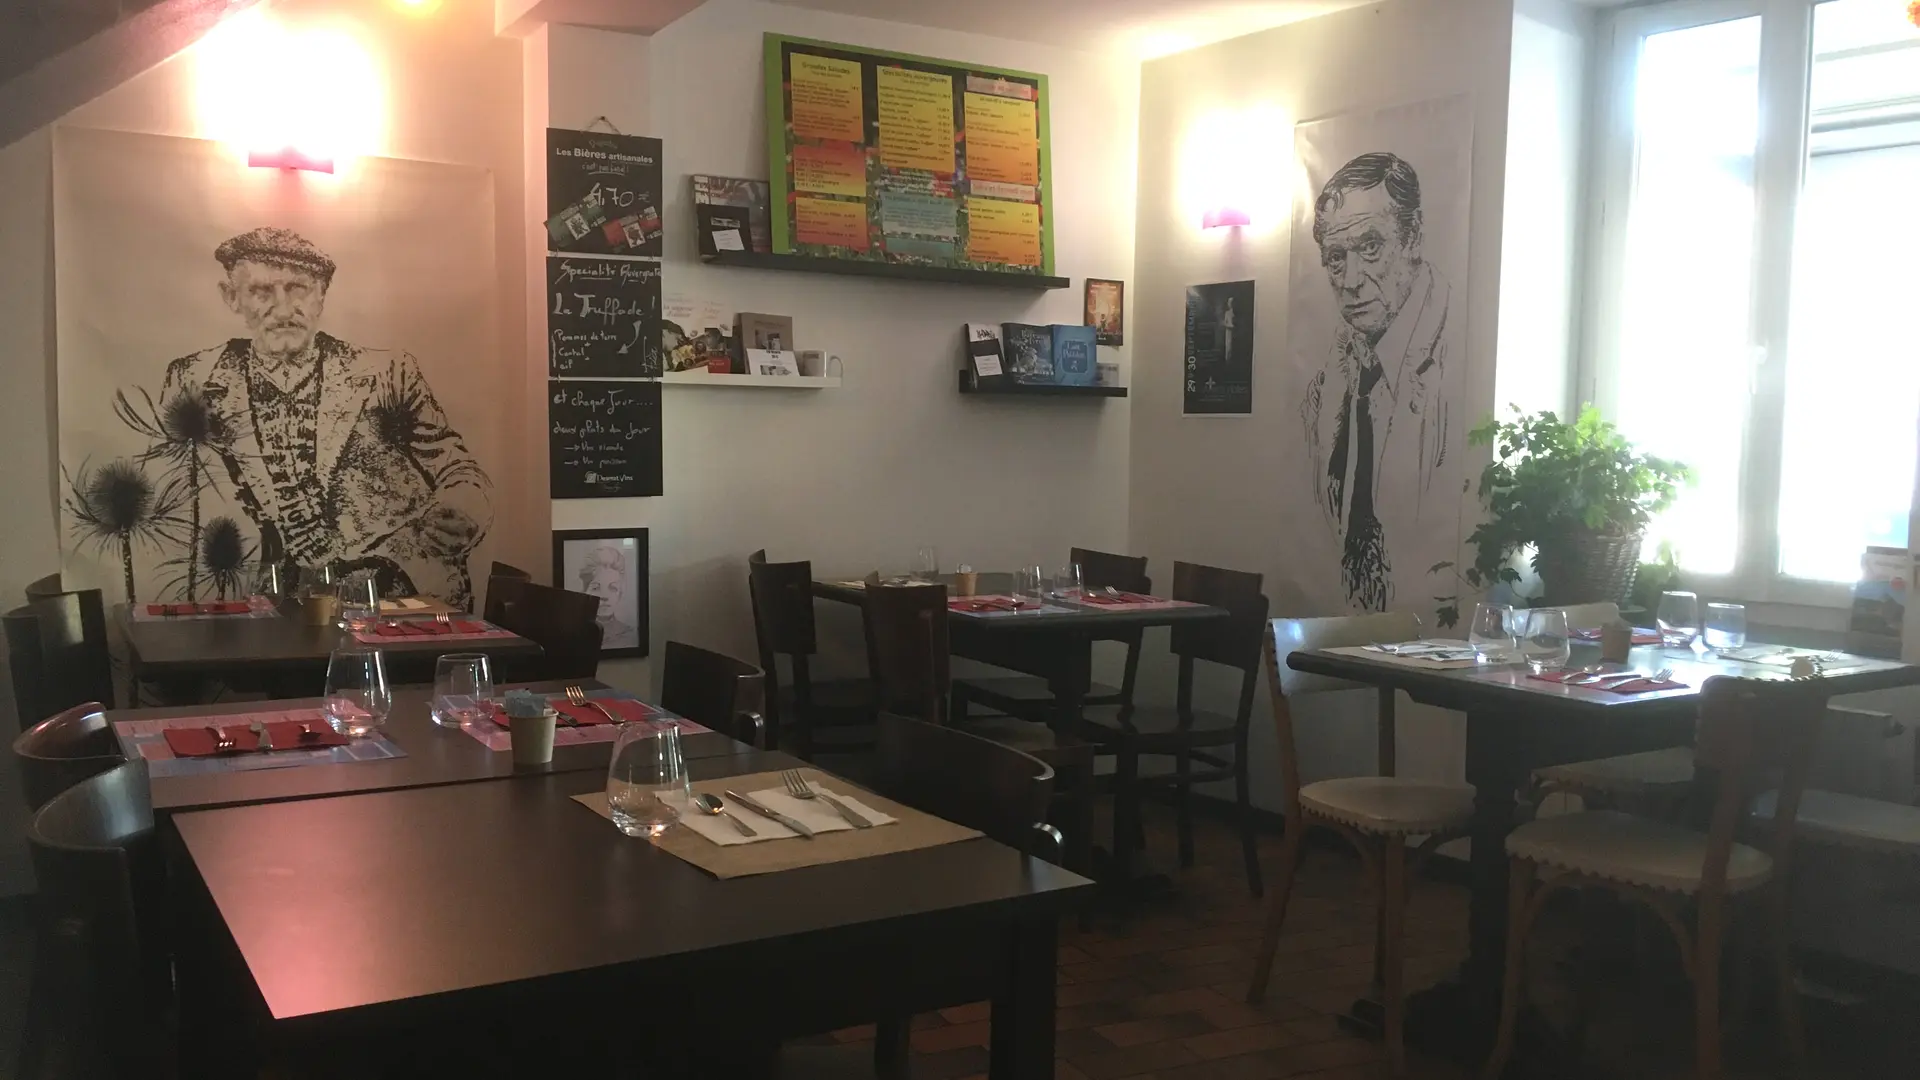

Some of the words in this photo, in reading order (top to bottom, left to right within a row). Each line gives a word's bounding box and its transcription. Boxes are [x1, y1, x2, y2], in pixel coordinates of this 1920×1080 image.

[556, 147, 572, 156] Les
[574, 147, 607, 160] Bières
[608, 152, 653, 164] artisanales
[553, 292, 573, 315] La
[574, 292, 645, 326] Truffade
[558, 346, 585, 357] Cantal
[1187, 356, 1197, 371] 30
[553, 388, 568, 404] et
[571, 390, 606, 413] chaque
[553, 420, 577, 434] deux
[579, 419, 605, 439] plats
